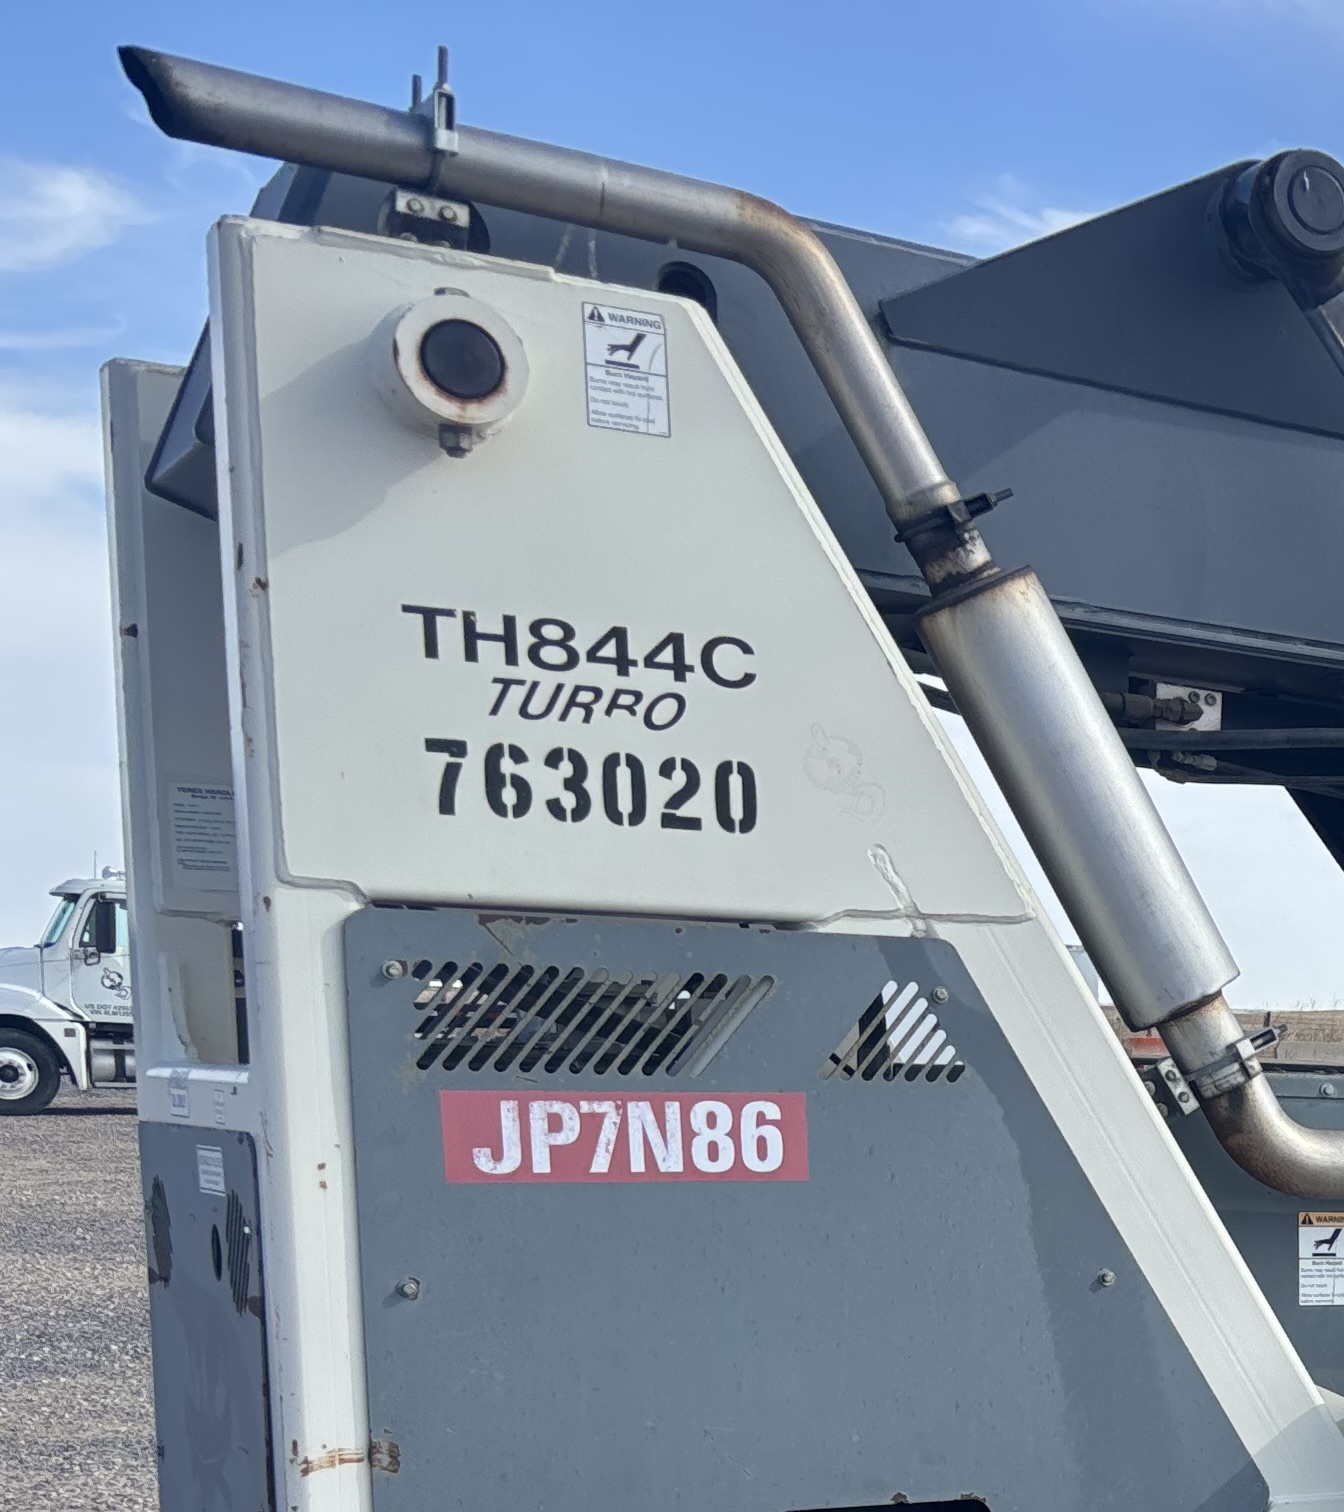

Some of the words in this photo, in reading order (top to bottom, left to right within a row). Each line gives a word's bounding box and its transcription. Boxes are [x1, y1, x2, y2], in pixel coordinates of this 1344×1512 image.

[608, 312, 661, 330] WARNING
[401, 603, 758, 690] TH844C
[424, 737, 759, 835] 763020
[471, 1099, 785, 1175] JP7N86
